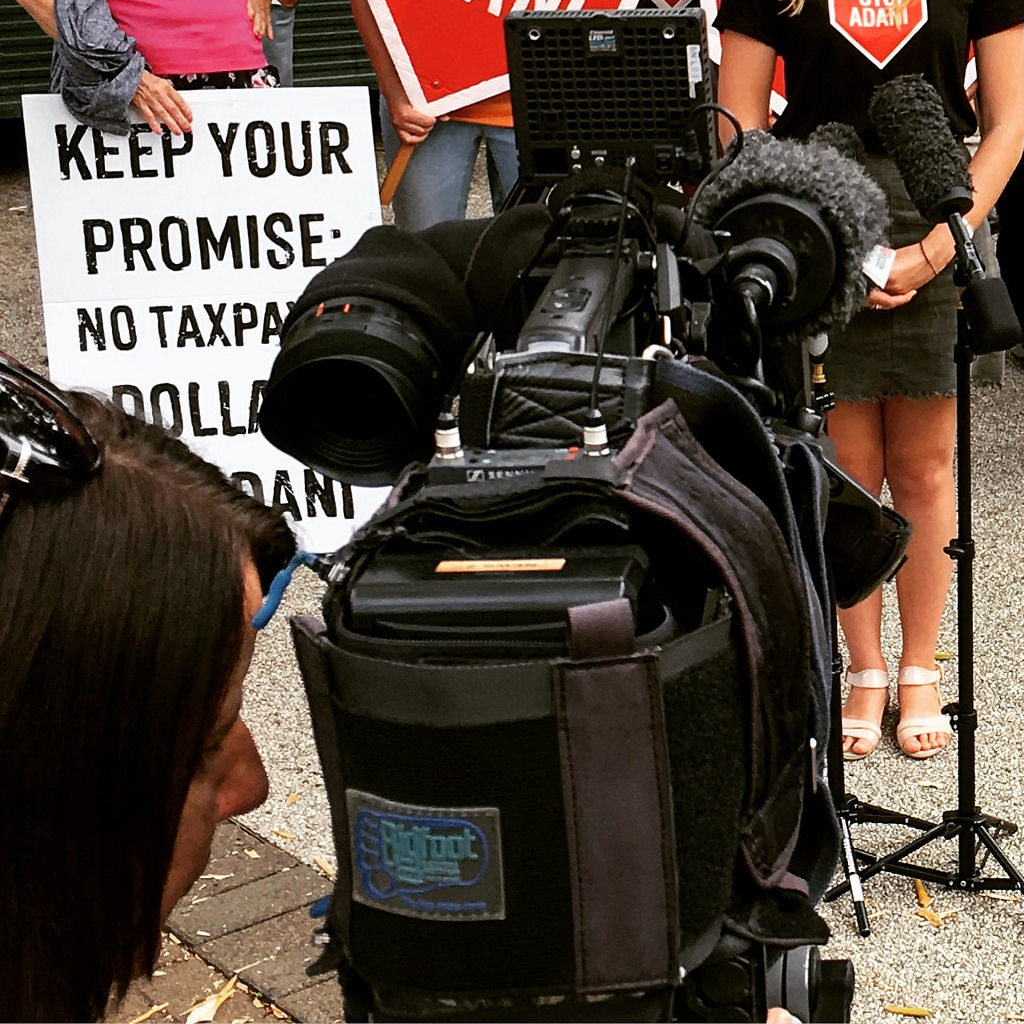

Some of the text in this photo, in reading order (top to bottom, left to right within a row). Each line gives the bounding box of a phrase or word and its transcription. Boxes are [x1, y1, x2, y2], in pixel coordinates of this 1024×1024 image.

[849, 6, 909, 27] ADANI
[54, 120, 353, 181] KEEP YOUR
[77, 305, 137, 352] NO
[231, 469, 355, 521] DANI
